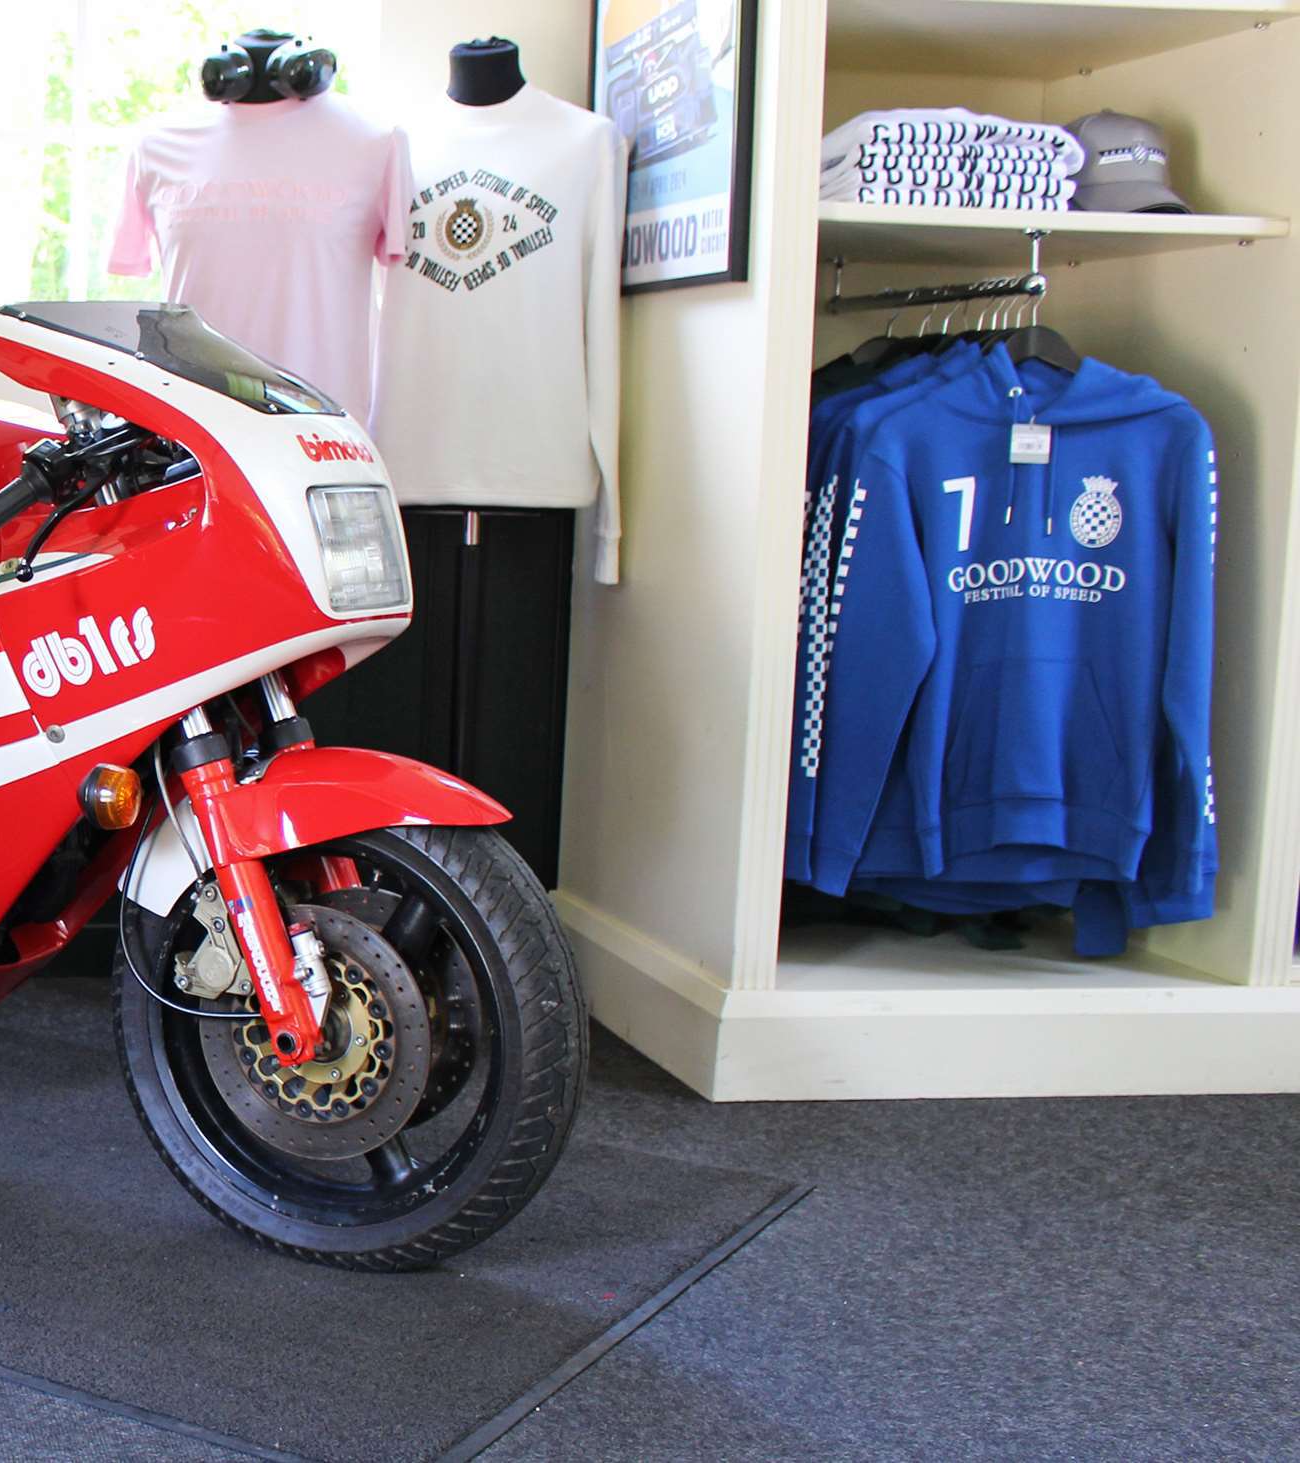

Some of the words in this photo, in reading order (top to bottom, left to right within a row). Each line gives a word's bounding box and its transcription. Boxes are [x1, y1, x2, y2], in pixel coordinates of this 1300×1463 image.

[419, 187, 433, 204] OF
[435, 170, 469, 197] SPEED
[470, 169, 513, 197] FESTIVAL
[511, 186, 529, 203] OF
[525, 194, 558, 224] SPEED
[412, 221, 426, 239] 20
[502, 214, 518, 233] 24
[509, 225, 554, 261] FESTIVAL
[418, 257, 462, 292] FESTIVAL
[463, 261, 497, 291] SPEED
[496, 251, 511, 271] OF
[296, 432, 374, 463] bimota
[947, 556, 1126, 593] GOODWOOD
[1029, 584, 1050, 599] OF
[1054, 587, 1102, 603] SPEED
